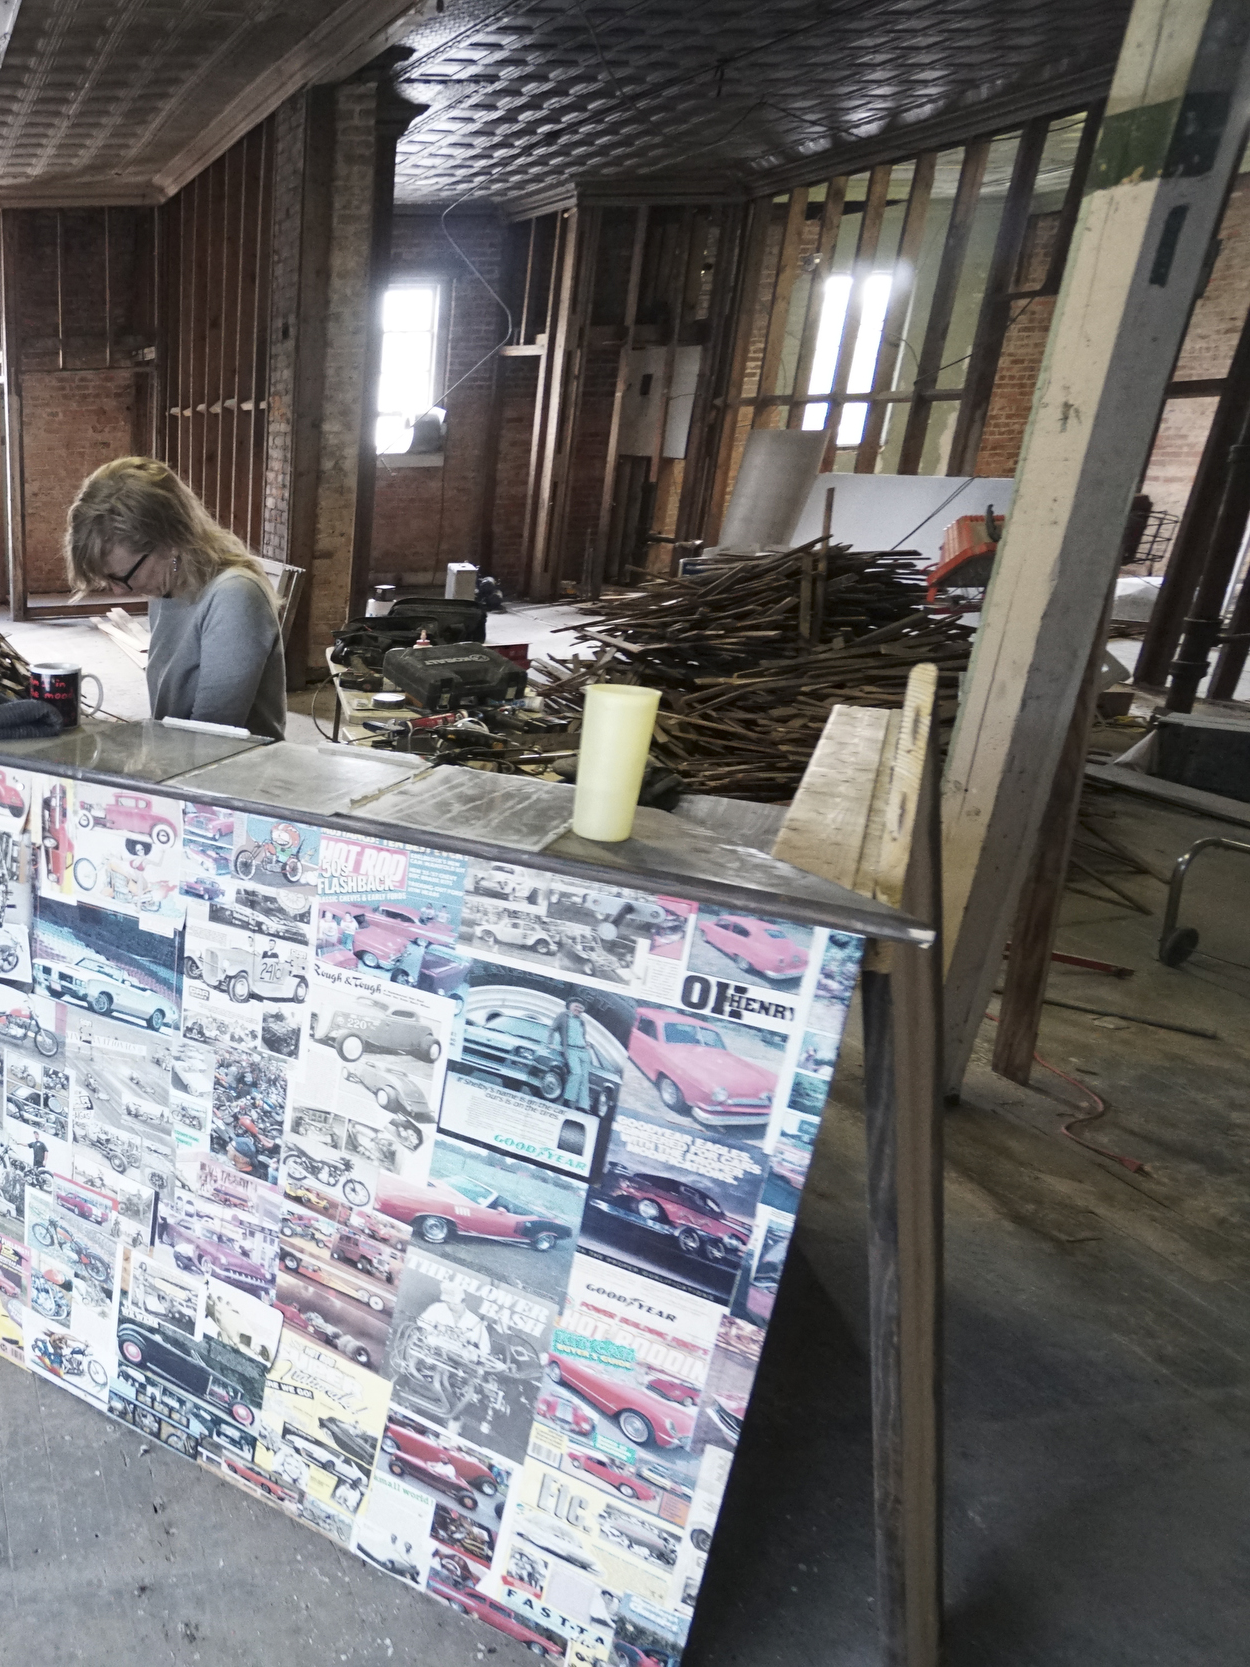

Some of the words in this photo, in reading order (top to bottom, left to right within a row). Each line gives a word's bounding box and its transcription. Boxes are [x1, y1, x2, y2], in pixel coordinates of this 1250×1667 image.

[424, 655, 472, 667] KOBALT
[44, 687, 74, 700] mood
[319, 839, 362, 874] HOT
[359, 847, 407, 882] ROD
[317, 874, 395, 895] FLASHBACK
[313, 963, 343, 984] Rough
[344, 976, 352, 986] &
[351, 976, 382, 996] Tough
[347, 1017, 368, 1030] 220
[464, 1078, 495, 1095] Shelby's
[496, 1088, 518, 1100] name
[518, 1094, 526, 1103] is
[526, 1099, 537, 1107] on
[538, 1101, 552, 1111] the
[485, 1092, 504, 1102] ours
[504, 1097, 512, 1105] is
[513, 1101, 524, 1110] on
[525, 1104, 537, 1114] the
[616, 1114, 693, 1145] GOODYEAR
[494, 1134, 587, 1171] GOODYEAR
[689, 1142, 720, 1161] FOR
[719, 1151, 762, 1175] CARS
[405, 1254, 452, 1284] THE
[585, 1284, 677, 1323] GOODYEAR
[560, 1309, 612, 1340] HOT
[281, 1384, 295, 1395] WE
[296, 1388, 313, 1399] GO!
